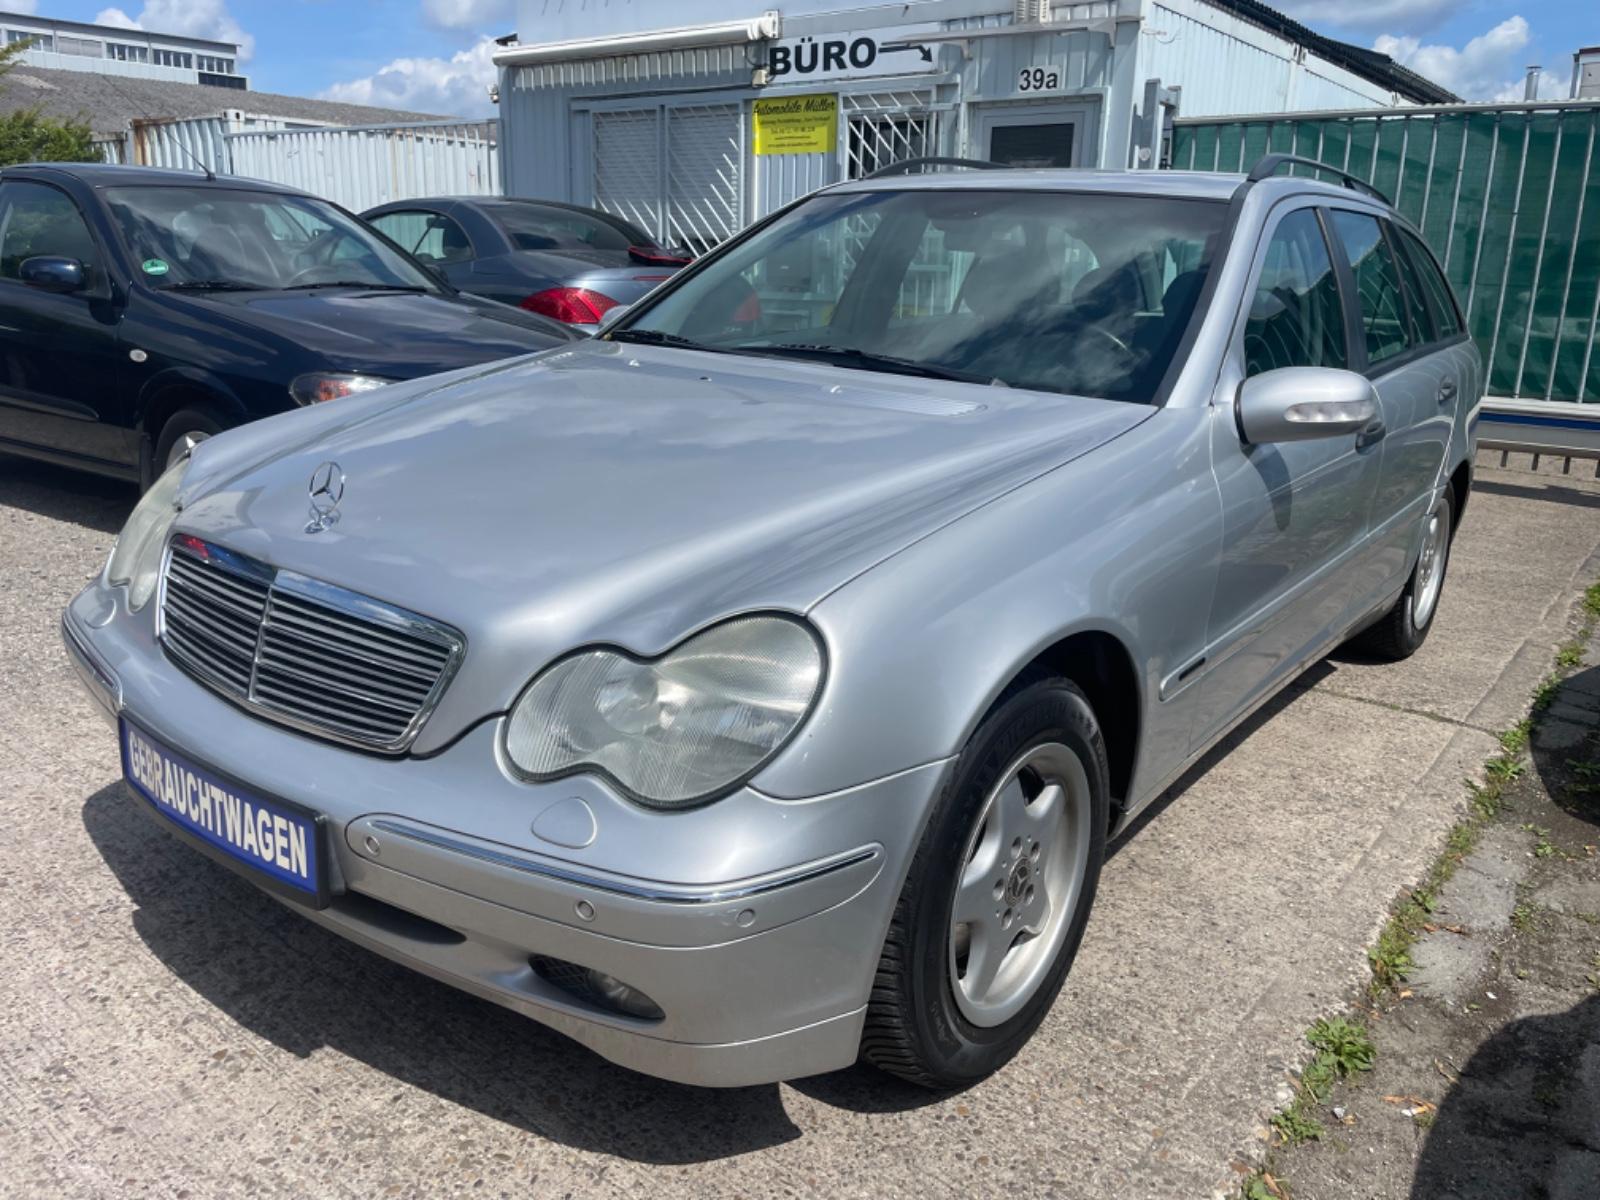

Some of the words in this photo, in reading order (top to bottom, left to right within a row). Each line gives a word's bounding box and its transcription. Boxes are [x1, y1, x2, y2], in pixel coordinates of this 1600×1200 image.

[769, 36, 877, 76] BÜRO
[1019, 68, 1058, 91] 39a
[129, 730, 308, 878] GEBRAUCHTWAGEN
